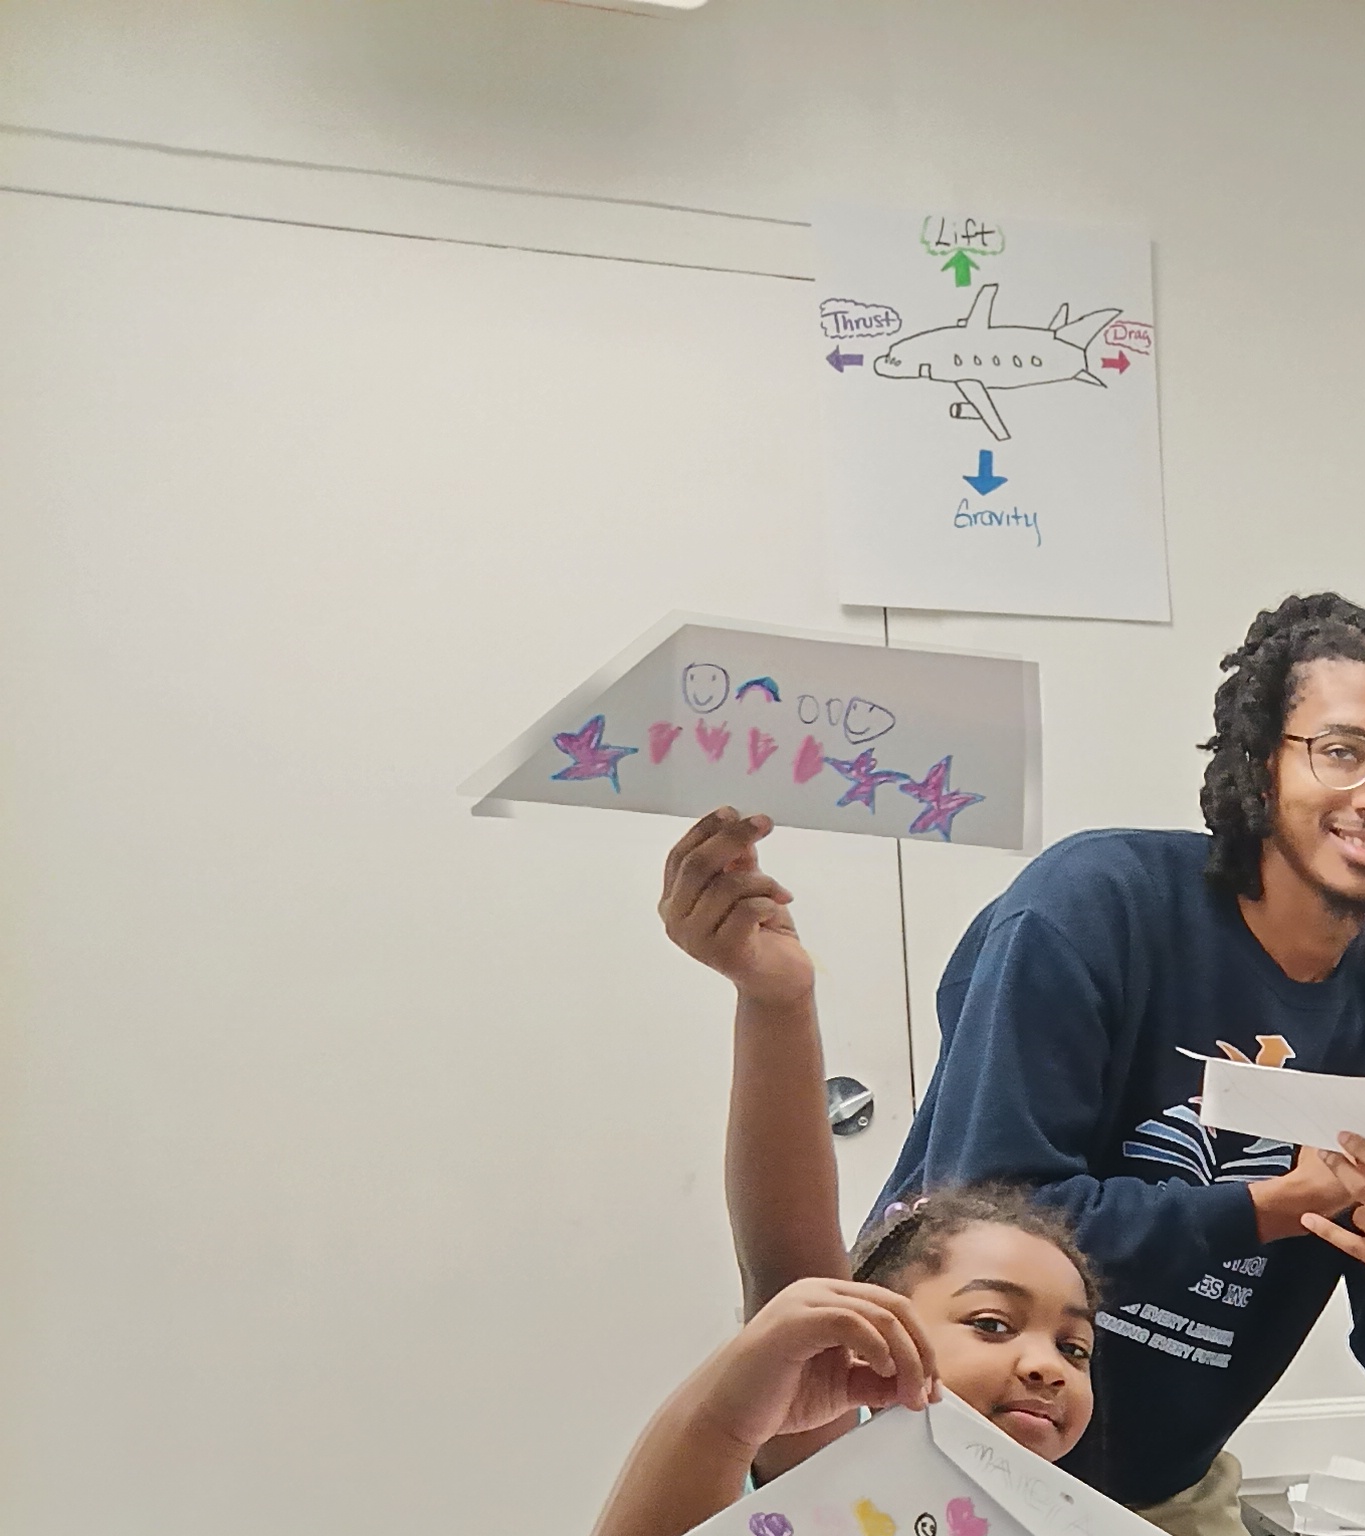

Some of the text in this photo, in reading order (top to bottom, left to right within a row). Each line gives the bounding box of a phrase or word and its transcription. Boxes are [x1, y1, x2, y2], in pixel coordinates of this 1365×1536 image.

[935, 218, 995, 247] Lift
[826, 310, 894, 329] Thrust
[1113, 327, 1150, 345] Drag
[954, 498, 1041, 547] Gravity
